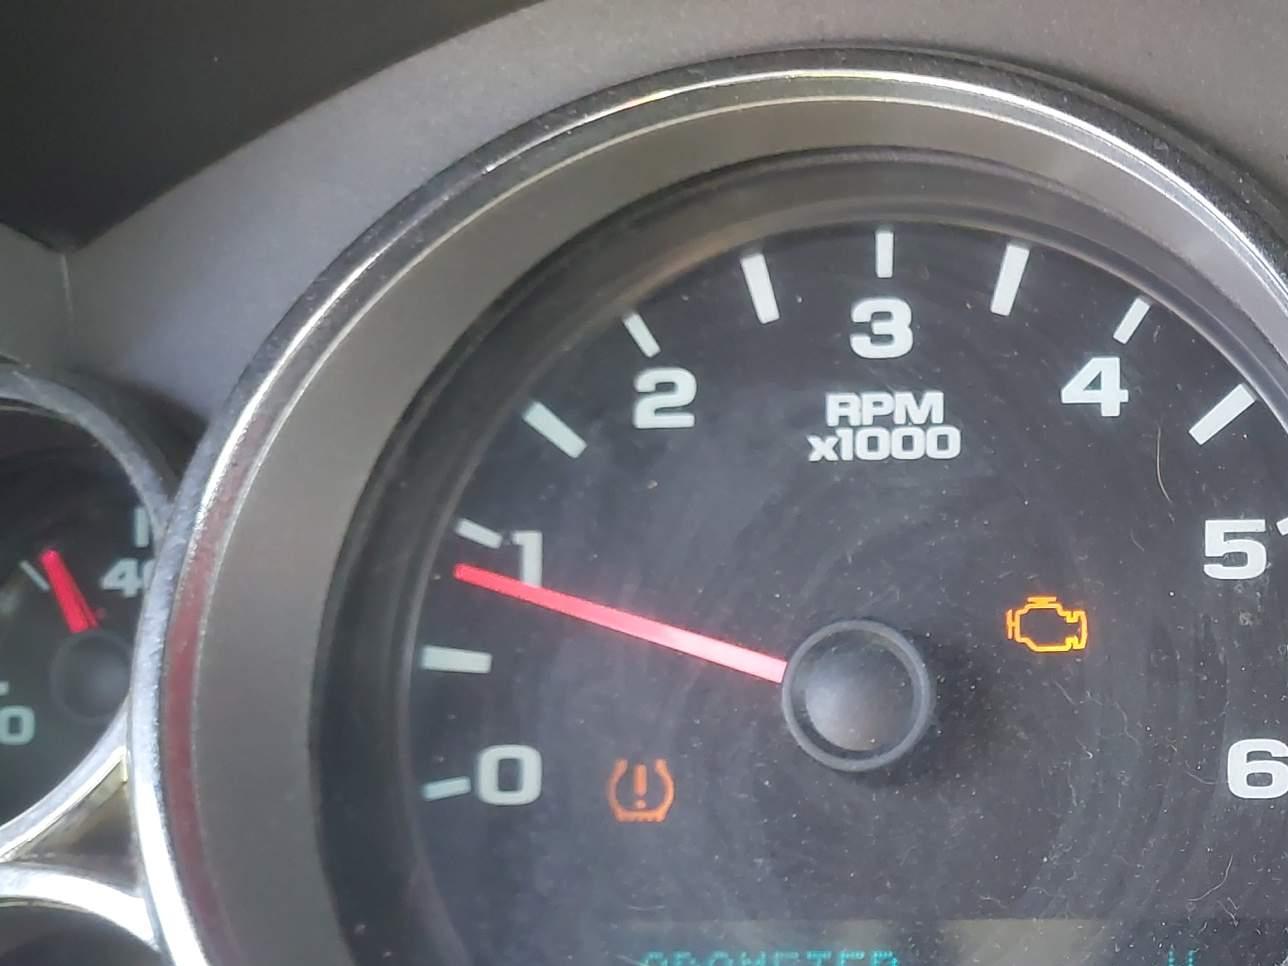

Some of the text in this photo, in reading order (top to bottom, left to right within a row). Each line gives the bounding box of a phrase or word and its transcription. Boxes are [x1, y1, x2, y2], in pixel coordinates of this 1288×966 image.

[850, 298, 913, 359] 3
[633, 367, 697, 429] 2
[826, 391, 944, 426] RPM
[1061, 356, 1129, 417] 4
[807, 426, 961, 461] x1000
[512, 530, 543, 590] 1
[1203, 519, 1267, 580] 5
[475, 745, 543, 806] 0
